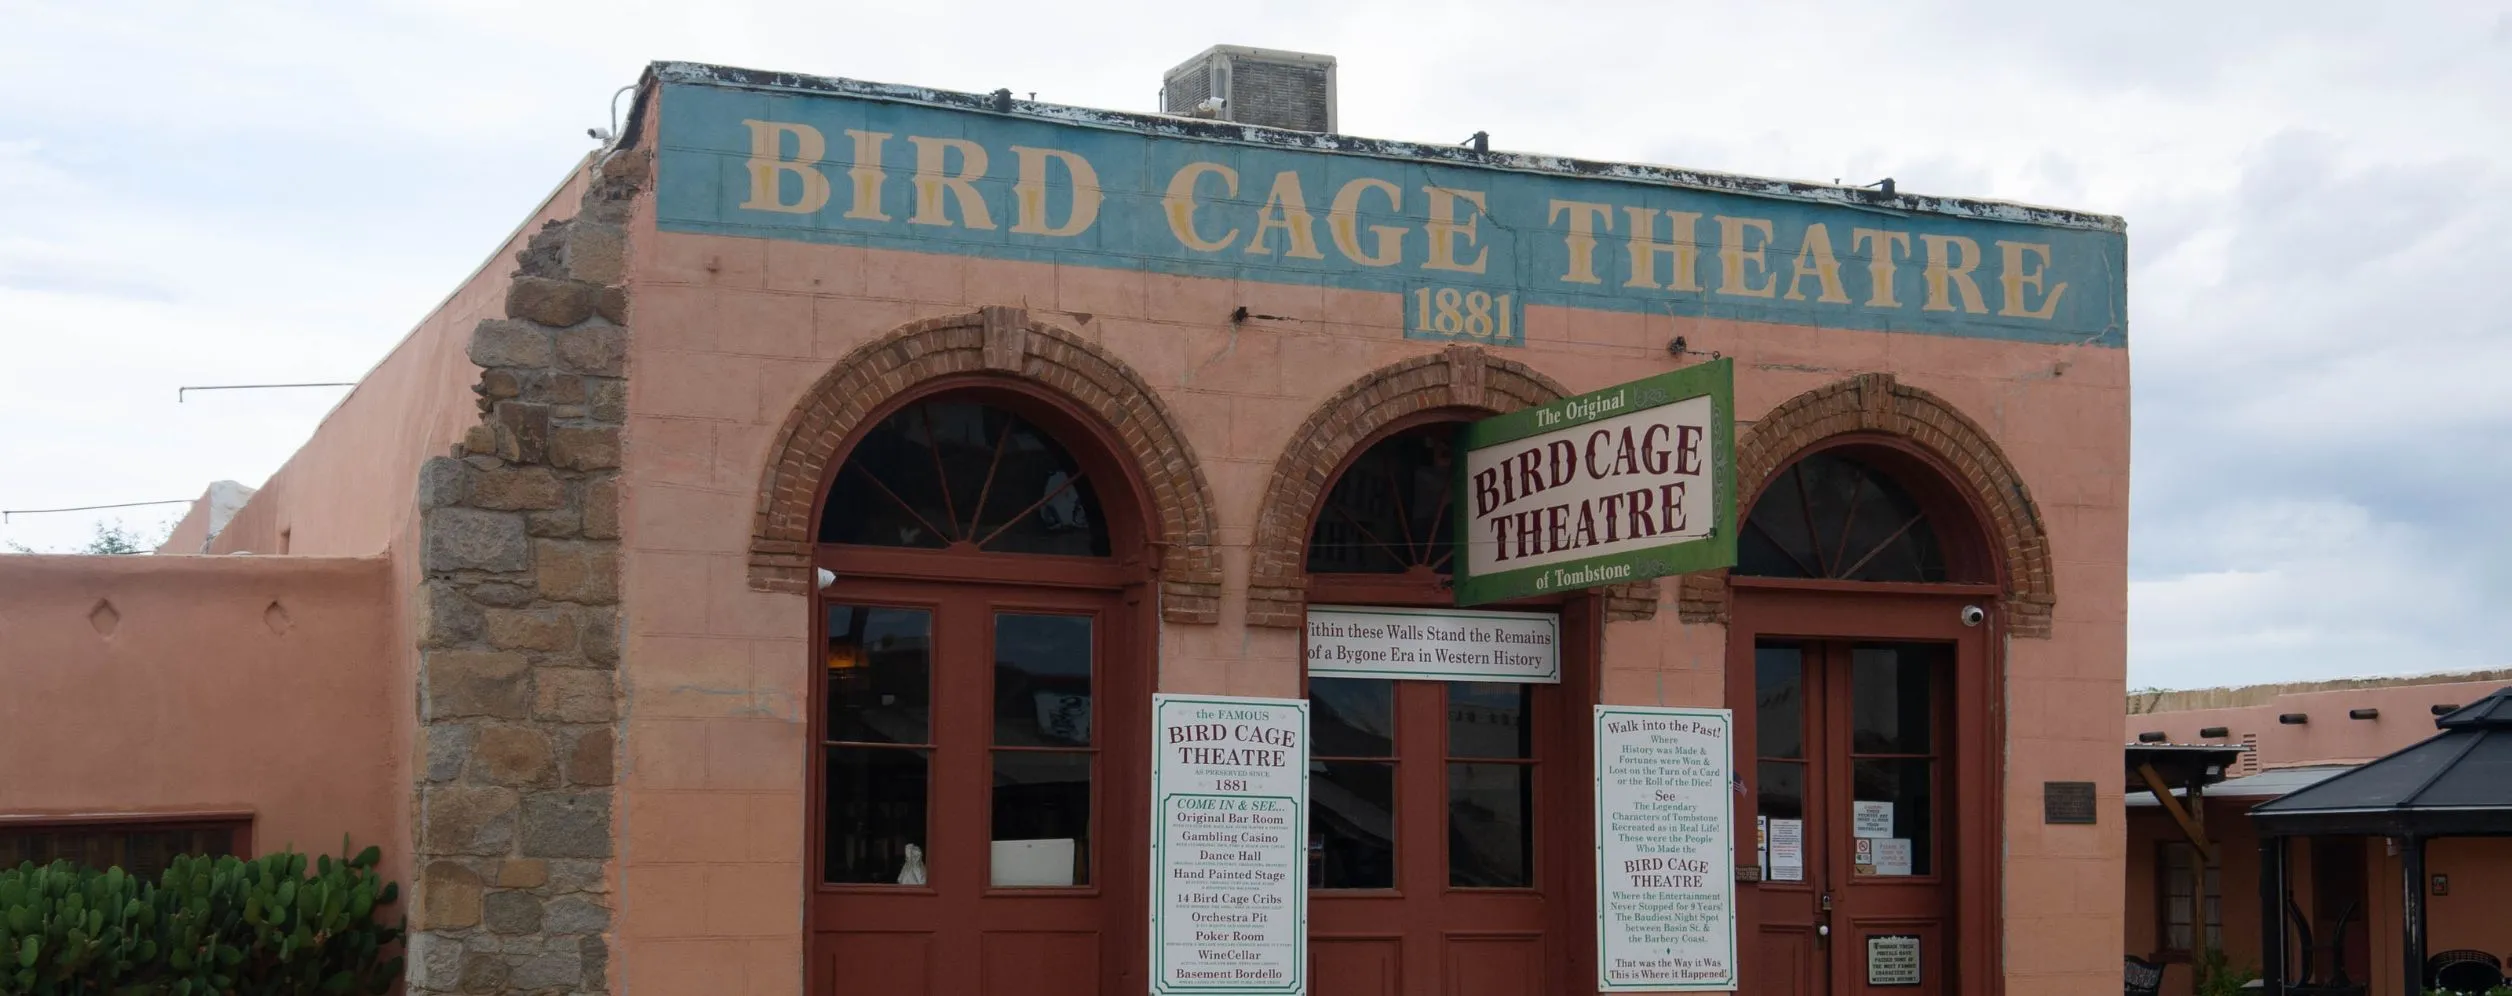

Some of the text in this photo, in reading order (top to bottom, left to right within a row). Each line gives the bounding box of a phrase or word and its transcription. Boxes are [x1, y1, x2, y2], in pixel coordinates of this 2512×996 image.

[740, 119, 2069, 320] BIRD CAGE THEATRE
[1414, 287, 1512, 339] 1881
[1536, 390, 1625, 427] The Original
[1473, 424, 1703, 519] BIRD CAGE
[1490, 481, 1687, 562] THEATRE
[1536, 561, 1631, 590] of Tombstone
[1348, 624, 1383, 639] these
[1387, 624, 1423, 640] Walls
[1426, 626, 1465, 642] Stand
[1469, 628, 1491, 643] the
[1495, 629, 1551, 645] Remains
[1307, 645, 1542, 669] of a Bygone Era in Western History
[1197, 709, 1269, 720] the FAMOUS
[1608, 720, 1721, 738] Walk into the Past!
[1168, 724, 1295, 748] BIRD CAGE
[1650, 735, 1678, 744] Where
[1622, 745, 1653, 755] History
[1675, 746, 1697, 755] Made
[1700, 747, 1707, 755] &
[1179, 747, 1286, 767] THEATRE
[1619, 756, 1657, 764] Fortunes
[1683, 757, 1700, 765] Won
[1703, 758, 1710, 766] &
[1609, 766, 1627, 774] Lost
[1643, 767, 1656, 775] the
[1659, 767, 1679, 776] Turn
[1682, 767, 1690, 776] of
[1700, 768, 1720, 776] Card
[1216, 780, 1248, 791] 1881
[1629, 777, 1643, 785] the
[1646, 778, 1662, 786] Roll
[1665, 778, 1673, 786] of
[1676, 778, 1690, 786] the
[1692, 779, 1712, 787] Dice!
[1656, 789, 1675, 801] See
[1177, 799, 1285, 811] COME IN & SEE...
[1634, 802, 1696, 812] The Legendary
[1177, 812, 1284, 824] Original Bar Room
[1612, 812, 1718, 822] Characters of Tombstone
[1612, 823, 1655, 831] Recreated
[1669, 824, 1677, 832] in
[1680, 824, 1698, 832] Real
[1701, 824, 1719, 832] Life!
[1182, 831, 1278, 843] Gambling Casino
[1619, 834, 1644, 842] These
[1669, 834, 1681, 842] the
[1685, 834, 1713, 845] People
[1636, 845, 1696, 853] Who Made the
[1200, 850, 1261, 861] Dance Hall
[1624, 858, 1709, 874] BIRD CAGE
[1174, 868, 1285, 881] Hand Painted Stage
[1631, 875, 1703, 888] THEATRE
[1178, 893, 1281, 905] 14 Bird Cage Cribs
[1612, 891, 1720, 900] Where the Entertainment
[1611, 902, 1636, 910] Never
[1639, 902, 1673, 912] Stopped
[1676, 902, 1688, 910] for
[1192, 912, 1268, 922] Orchestra Pit
[1616, 913, 1632, 921] The
[1674, 913, 1698, 922] Night
[1701, 913, 1719, 922] Spot
[1626, 924, 1661, 932] between
[1664, 924, 1687, 932] Basin
[1703, 924, 1710, 932] &
[1196, 931, 1264, 941] Poker Room
[1628, 935, 1642, 943] the
[1616, 959, 1636, 968] That
[1658, 959, 1672, 967] the
[1674, 958, 1692, 970] Way
[1695, 959, 1702, 967] it
[1703, 958, 1721, 967] Was
[1176, 968, 1282, 979] Basement Bordello
[1610, 969, 1727, 980] This is Where it Happened!
